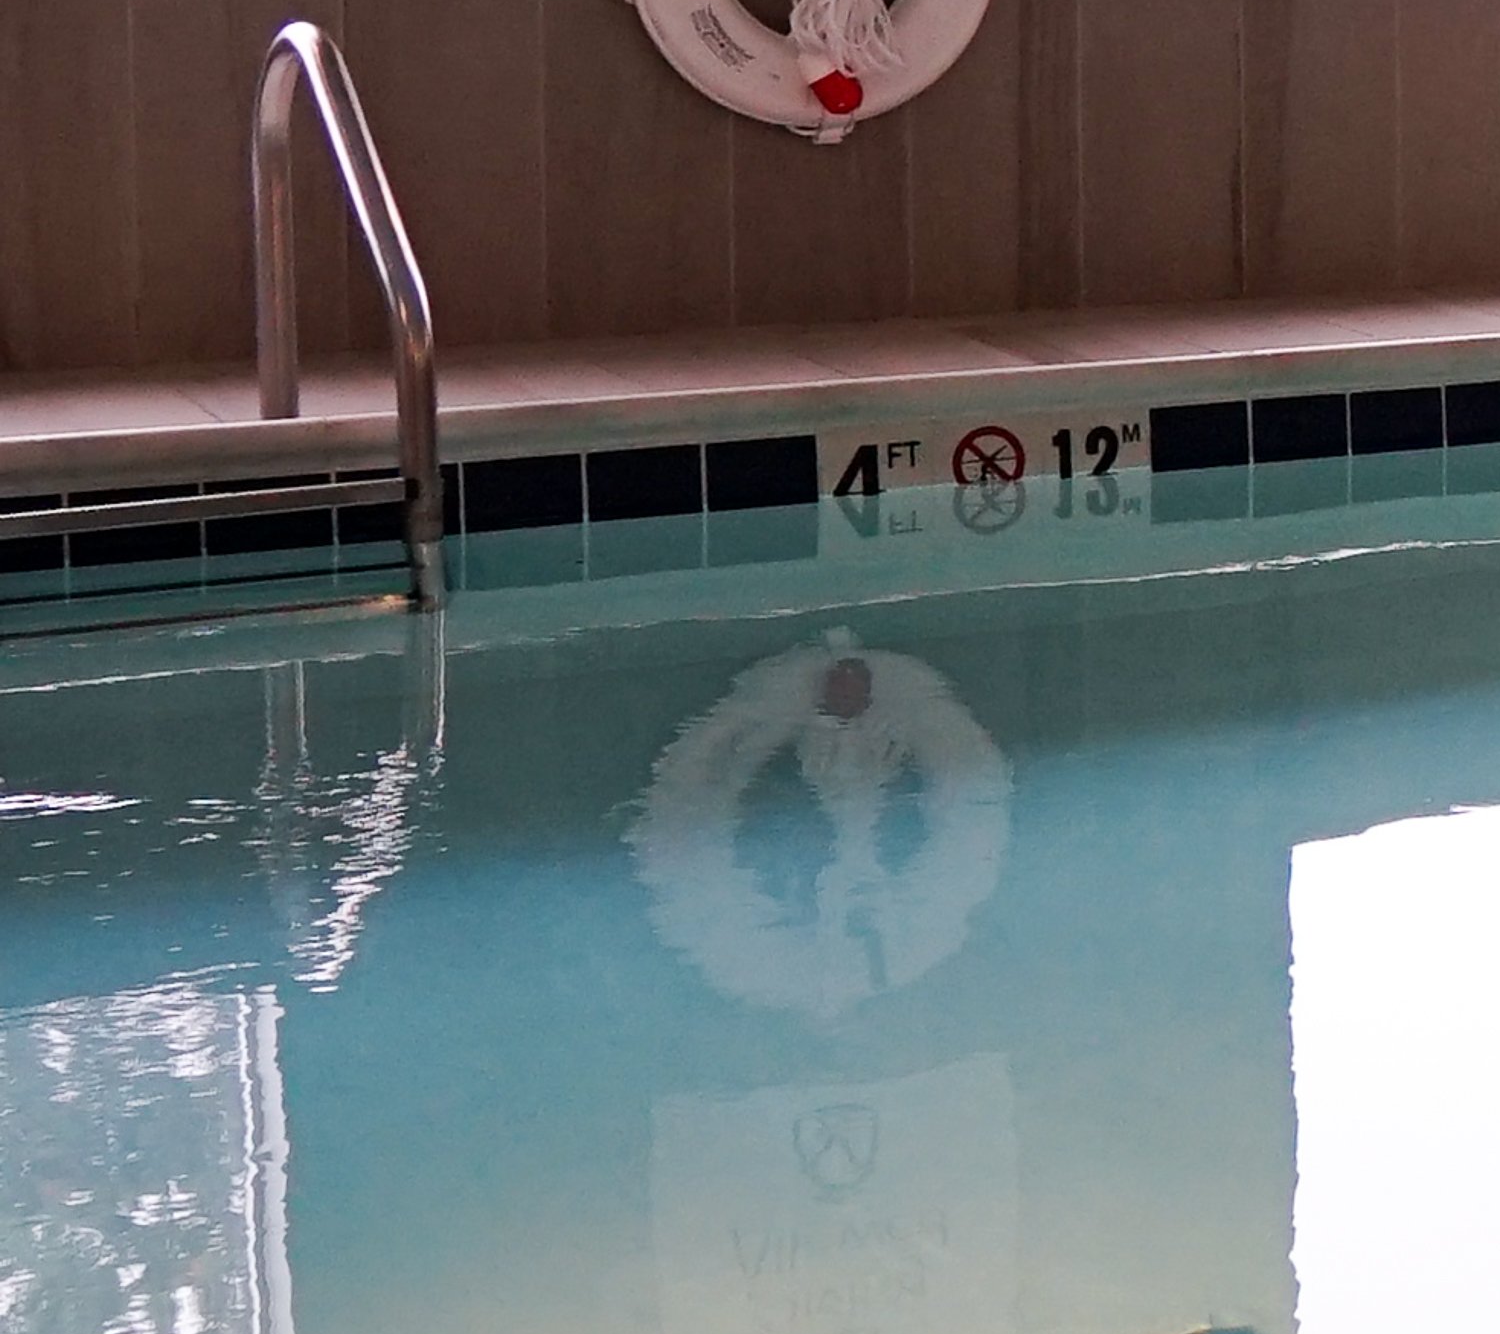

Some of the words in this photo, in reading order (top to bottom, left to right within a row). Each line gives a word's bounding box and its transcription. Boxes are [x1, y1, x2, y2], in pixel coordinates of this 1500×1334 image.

[833, 444, 885, 496] 4
[887, 441, 921, 468] FT
[1052, 425, 1119, 480] 12
[1122, 423, 1141, 445] M
